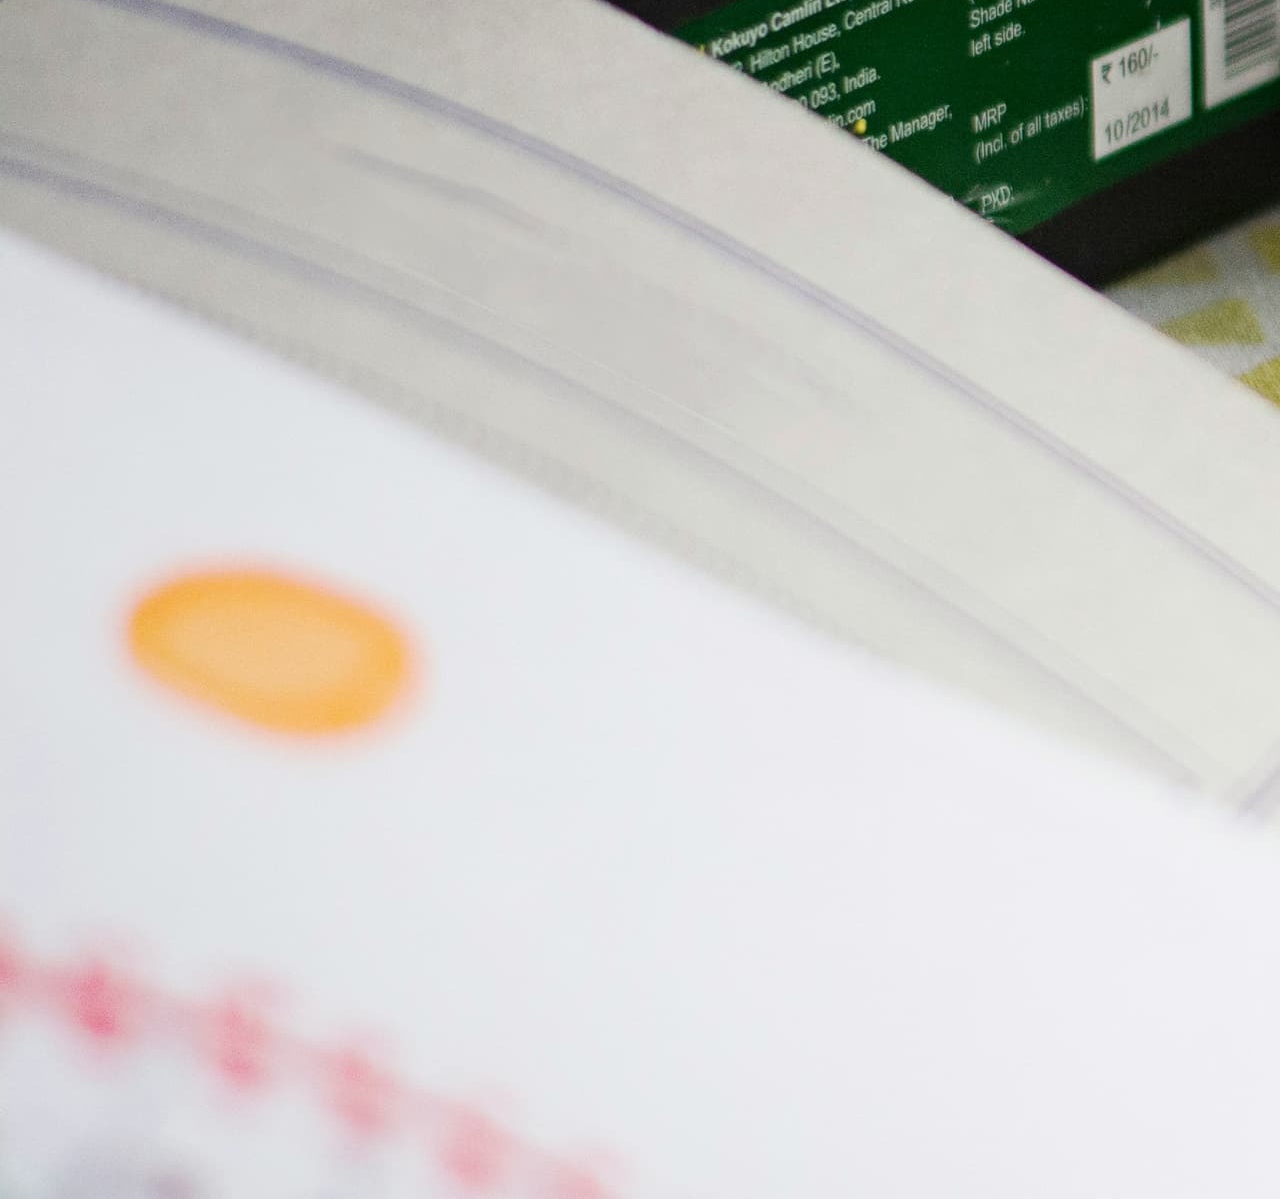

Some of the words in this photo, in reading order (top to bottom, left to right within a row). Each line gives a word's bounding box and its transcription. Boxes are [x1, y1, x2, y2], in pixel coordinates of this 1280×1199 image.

[969, 0, 1013, 29] Shade
[711, 23, 768, 57] Kokuyo
[970, 33, 992, 57] left
[750, 42, 790, 72] Hilton
[1119, 45, 1159, 77] 160/-
[766, 61, 813, 92] ndheri
[972, 102, 1007, 133] MRP
[1104, 97, 1171, 145] 10/2014
[975, 130, 1007, 164] (Incl.
[1010, 125, 1024, 143] of
[1027, 115, 1042, 137] all
